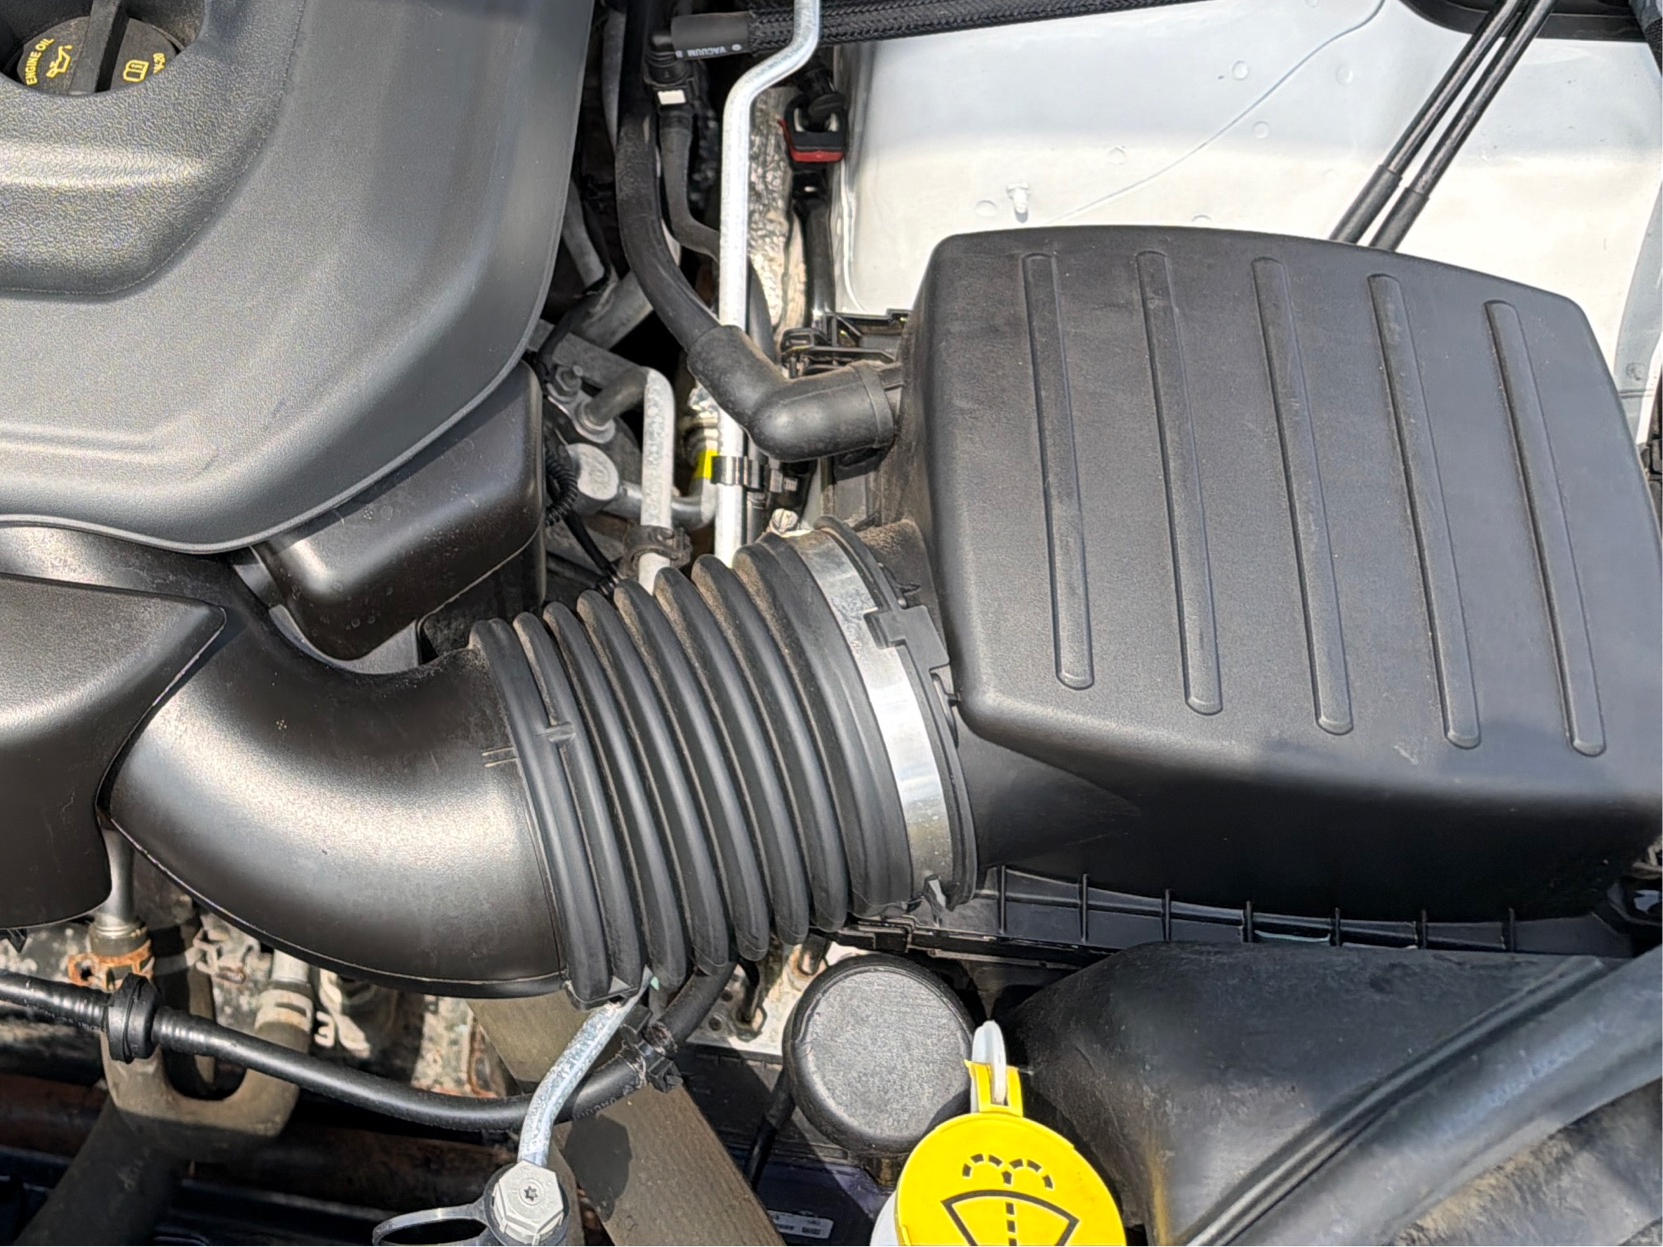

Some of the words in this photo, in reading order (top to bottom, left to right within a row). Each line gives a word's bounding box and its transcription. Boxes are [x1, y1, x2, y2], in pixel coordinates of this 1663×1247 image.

[25, 51, 42, 85] ENGINE
[35, 38, 55, 51] OIL
[687, 46, 727, 57] VACUUM
